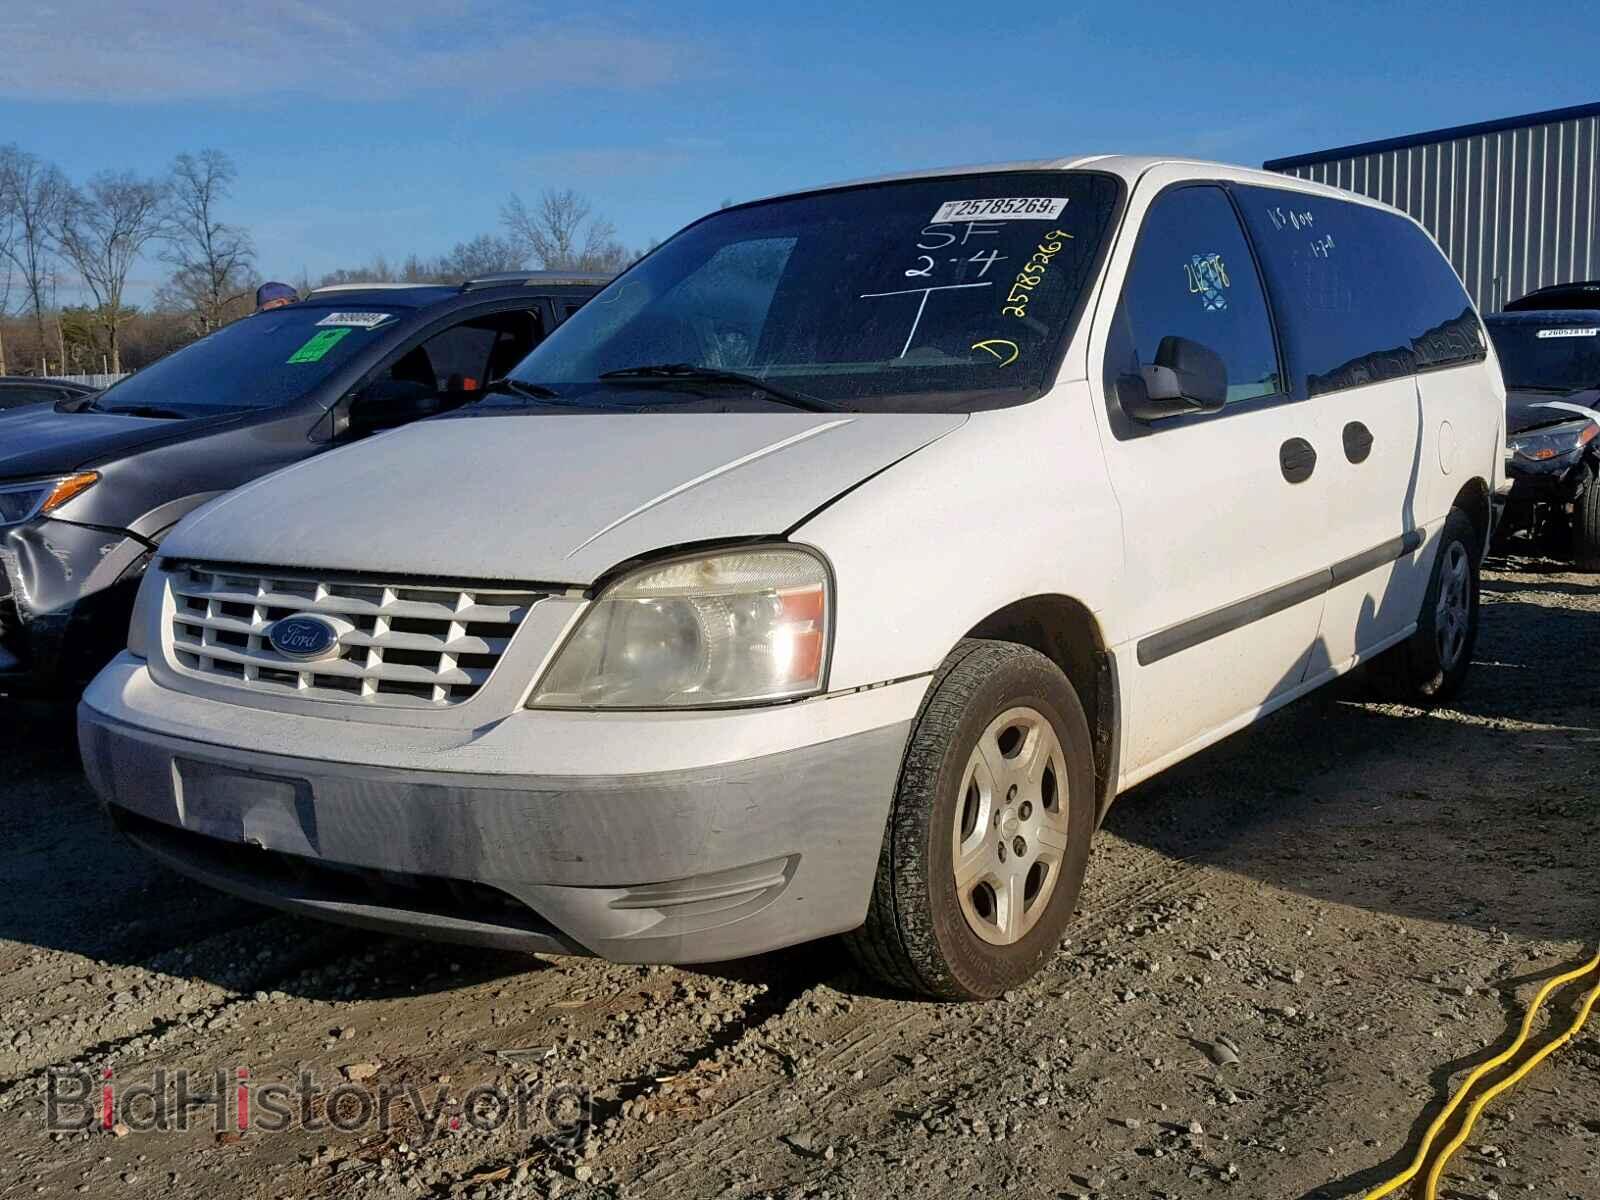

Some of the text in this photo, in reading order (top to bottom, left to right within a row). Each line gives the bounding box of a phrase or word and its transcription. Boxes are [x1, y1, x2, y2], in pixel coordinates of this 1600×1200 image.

[955, 198, 1052, 217] 25785269
[916, 222, 1006, 250] SF
[1003, 230, 1074, 317] 25785269
[282, 623, 319, 647] Ford
